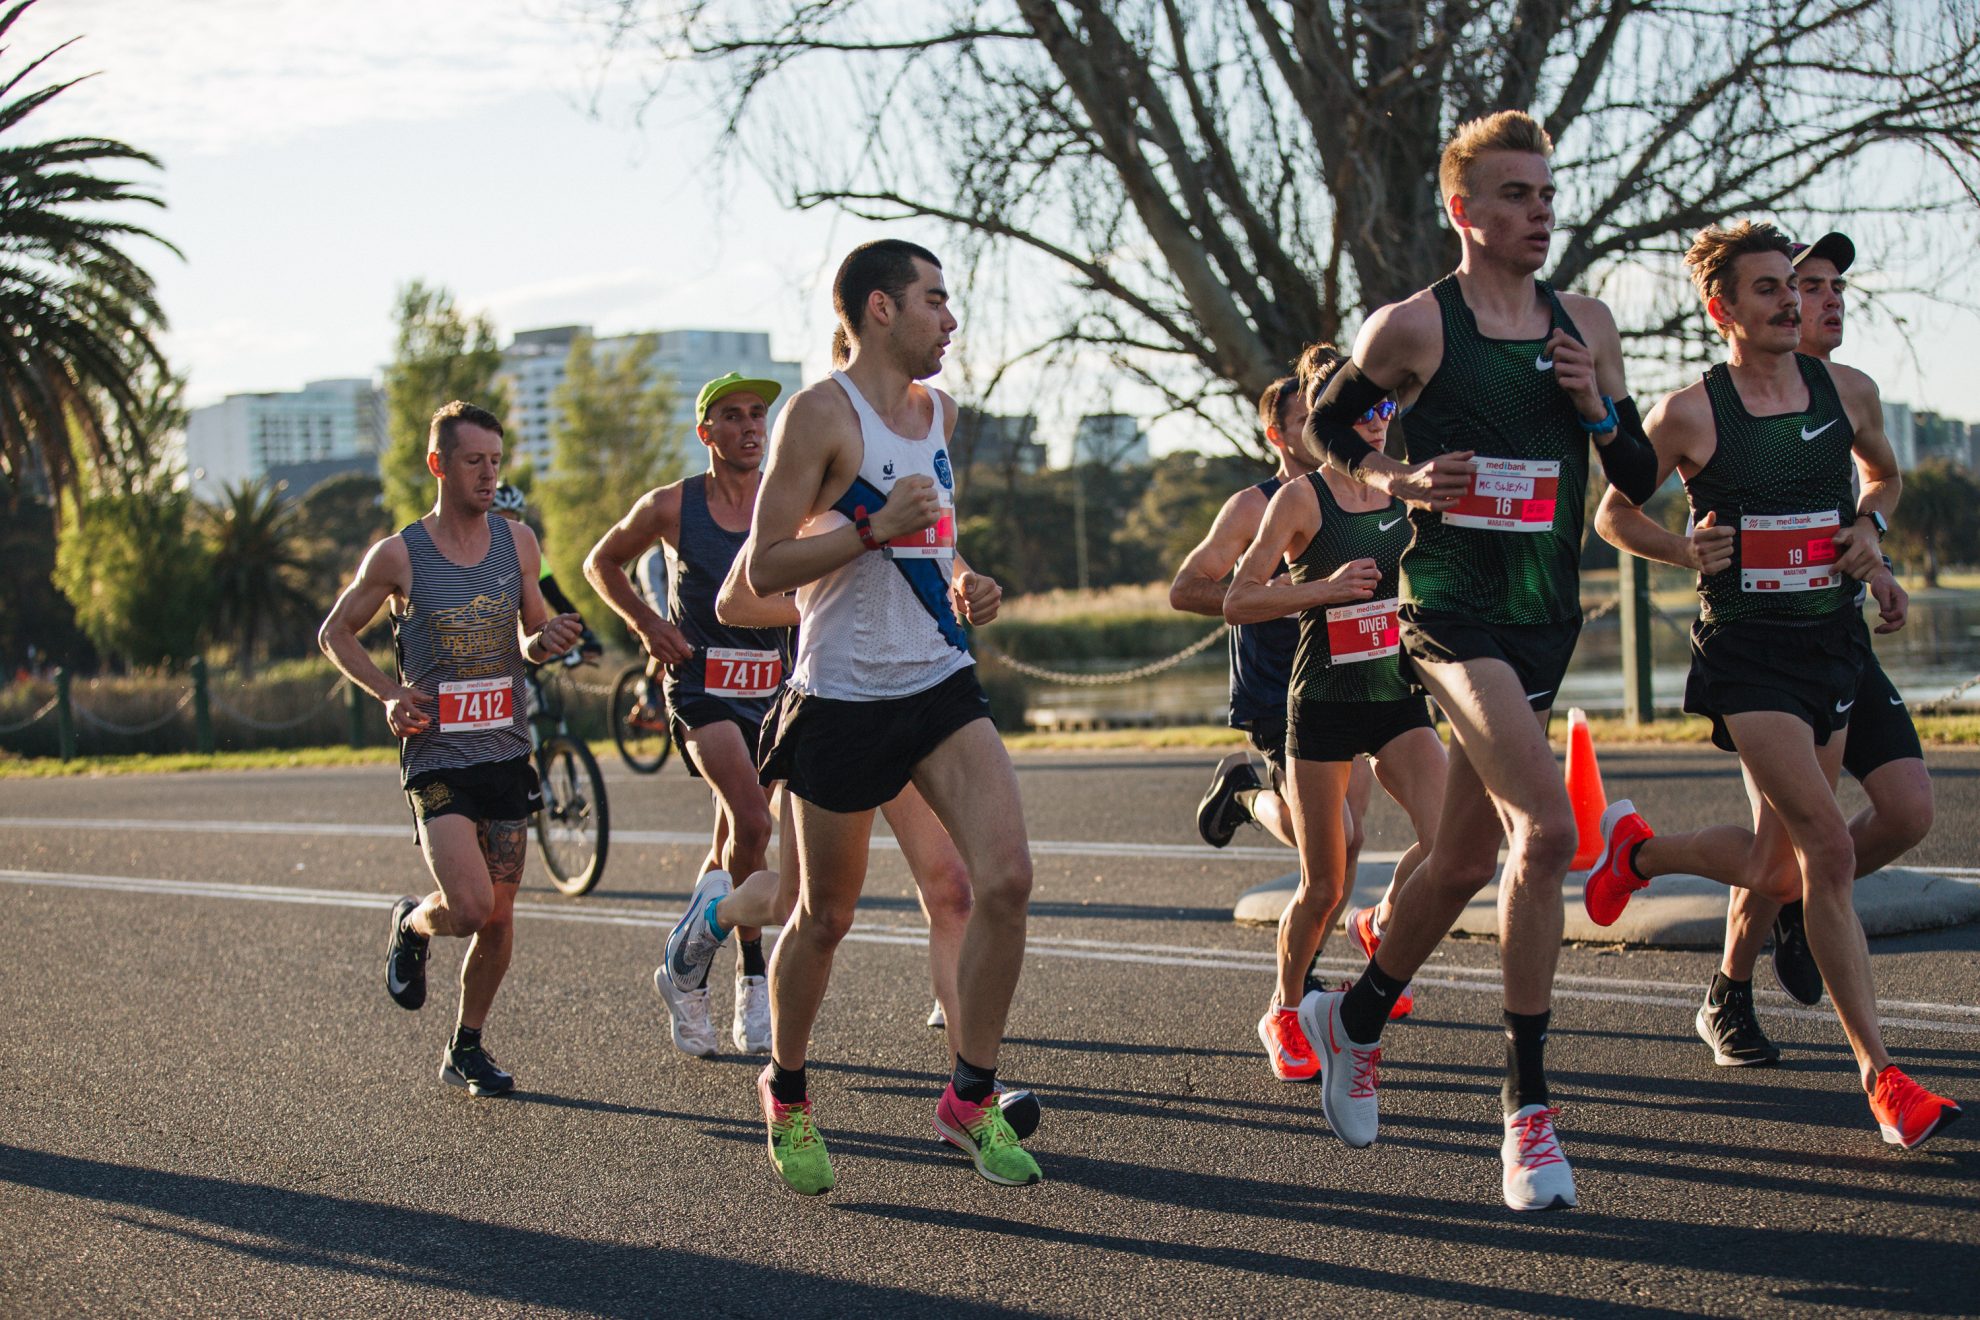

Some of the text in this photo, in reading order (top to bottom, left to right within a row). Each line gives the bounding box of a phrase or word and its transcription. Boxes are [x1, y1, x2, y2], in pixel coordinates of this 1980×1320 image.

[1486, 462, 1526, 471] medibank
[1495, 498, 1512, 515] 16
[1487, 519, 1515, 528] MARATHON
[1776, 516, 1811, 526] medibank
[925, 528, 936, 544] 18
[1788, 549, 1803, 565] 19
[1356, 603, 1386, 614] medibank
[1358, 615, 1388, 634] DIVER
[1372, 632, 1380, 647] 5
[1367, 649, 1387, 657] MARATHON
[721, 661, 773, 688] 7411
[454, 691, 504, 721] 7412
